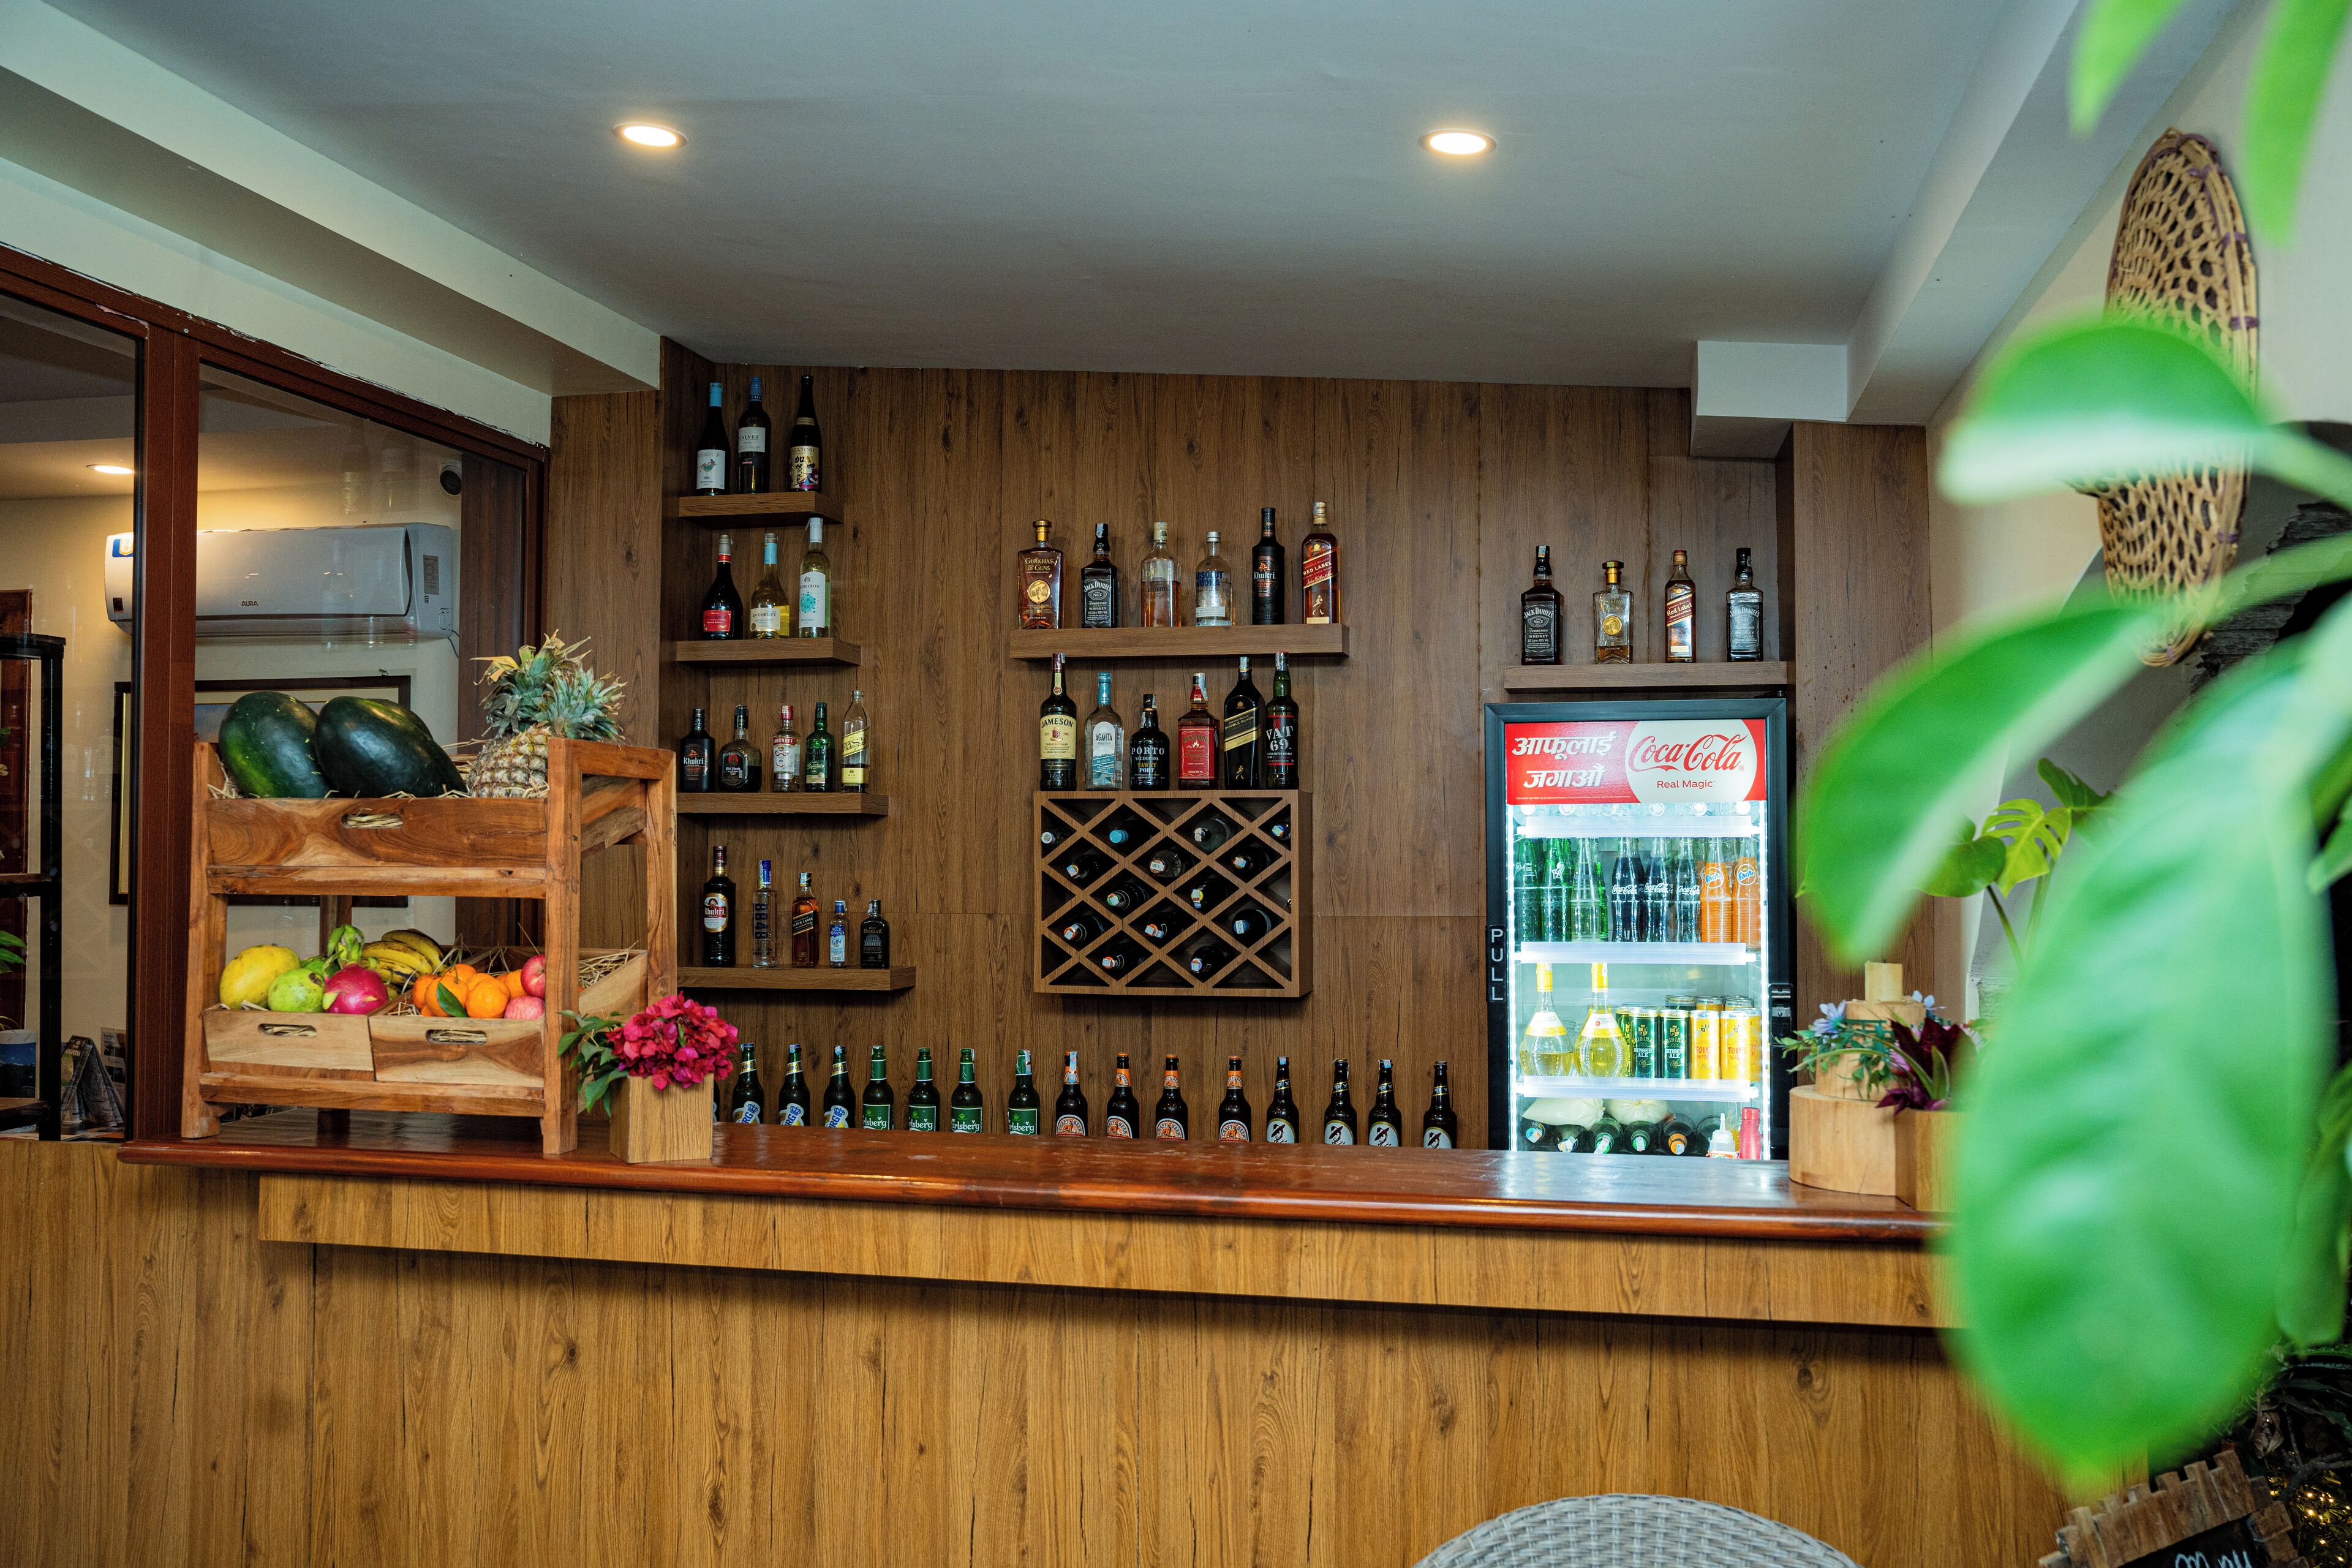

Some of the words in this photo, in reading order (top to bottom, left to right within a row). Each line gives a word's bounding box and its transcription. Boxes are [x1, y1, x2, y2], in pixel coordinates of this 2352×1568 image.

[1314, 561, 1332, 571] LABEL
[1084, 583, 1095, 592] JACK
[1523, 609, 1536, 619] JACK
[1667, 608, 1678, 616] Red
[1677, 602, 1692, 612] Label
[1041, 718, 1073, 728] JAMESON
[1224, 722, 1240, 730] DOUBLE
[1265, 725, 1294, 741] VAT
[1131, 747, 1165, 755] PORTO
[1270, 738, 1289, 752] 69
[1629, 734, 1749, 772] Coca-Cola
[1683, 780, 1713, 790] Magic
[1738, 869, 1755, 882] Fanta
[755, 903, 767, 939] 8848
[1491, 929, 1504, 1001] PULL
[1058, 1120, 1069, 1132] CRAFT
[1072, 1120, 1082, 1133] BEER
[1118, 1122, 1128, 1134] BEER
[1156, 1122, 1167, 1135] CRAFT
[1170, 1123, 1180, 1136] BEER
[1221, 1125, 1234, 1138] CRAFT
[1237, 1126, 1246, 1138] BEER
